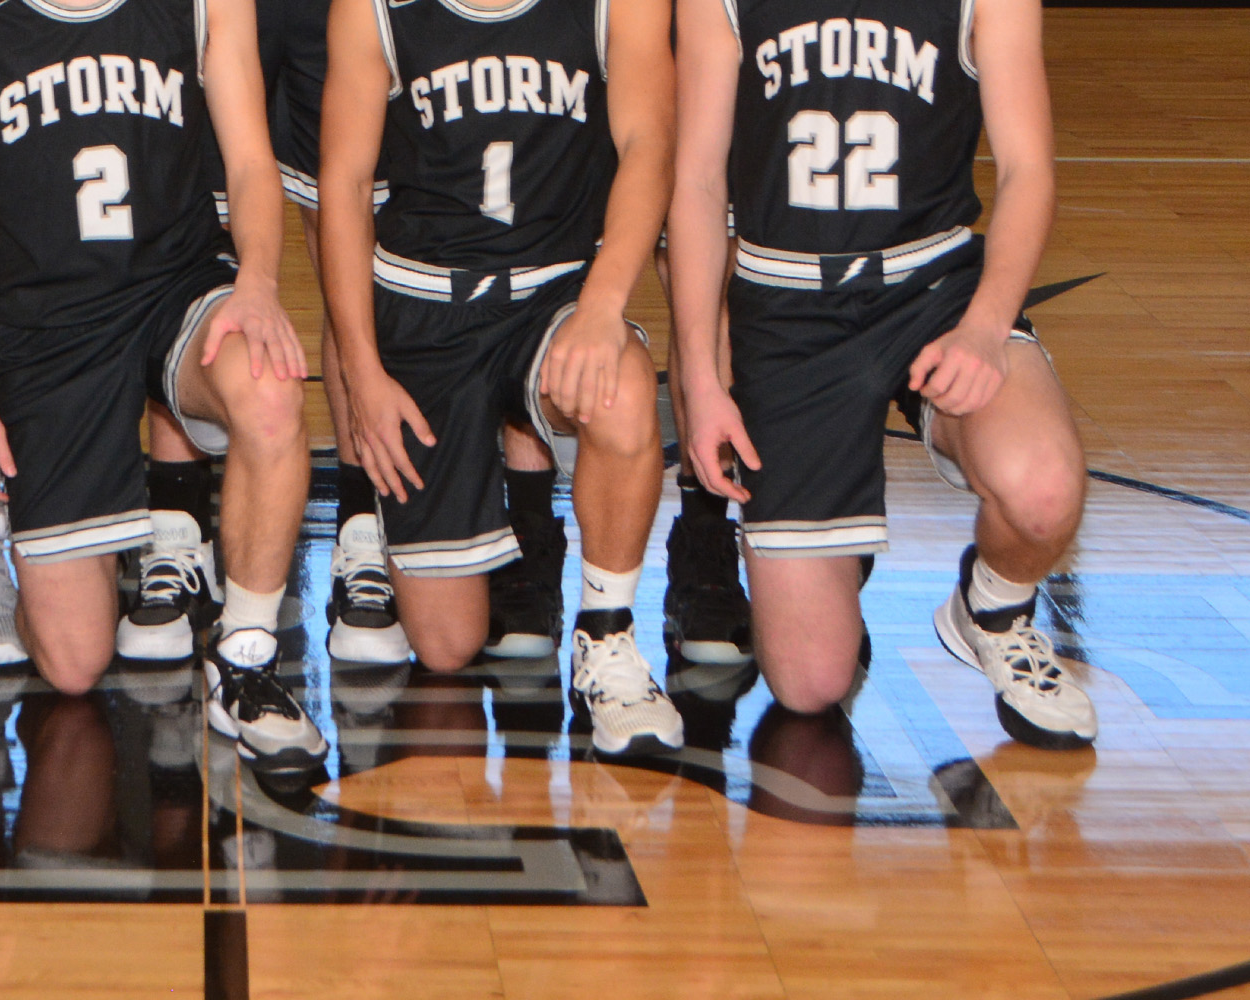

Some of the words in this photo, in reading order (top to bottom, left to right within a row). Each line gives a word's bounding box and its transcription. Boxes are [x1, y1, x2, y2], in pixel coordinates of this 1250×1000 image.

[410, 55, 590, 131] STORM
[755, 18, 939, 105] STORM
[72, 145, 134, 241] 2
[479, 140, 516, 226] 1
[787, 110, 899, 211] 22
